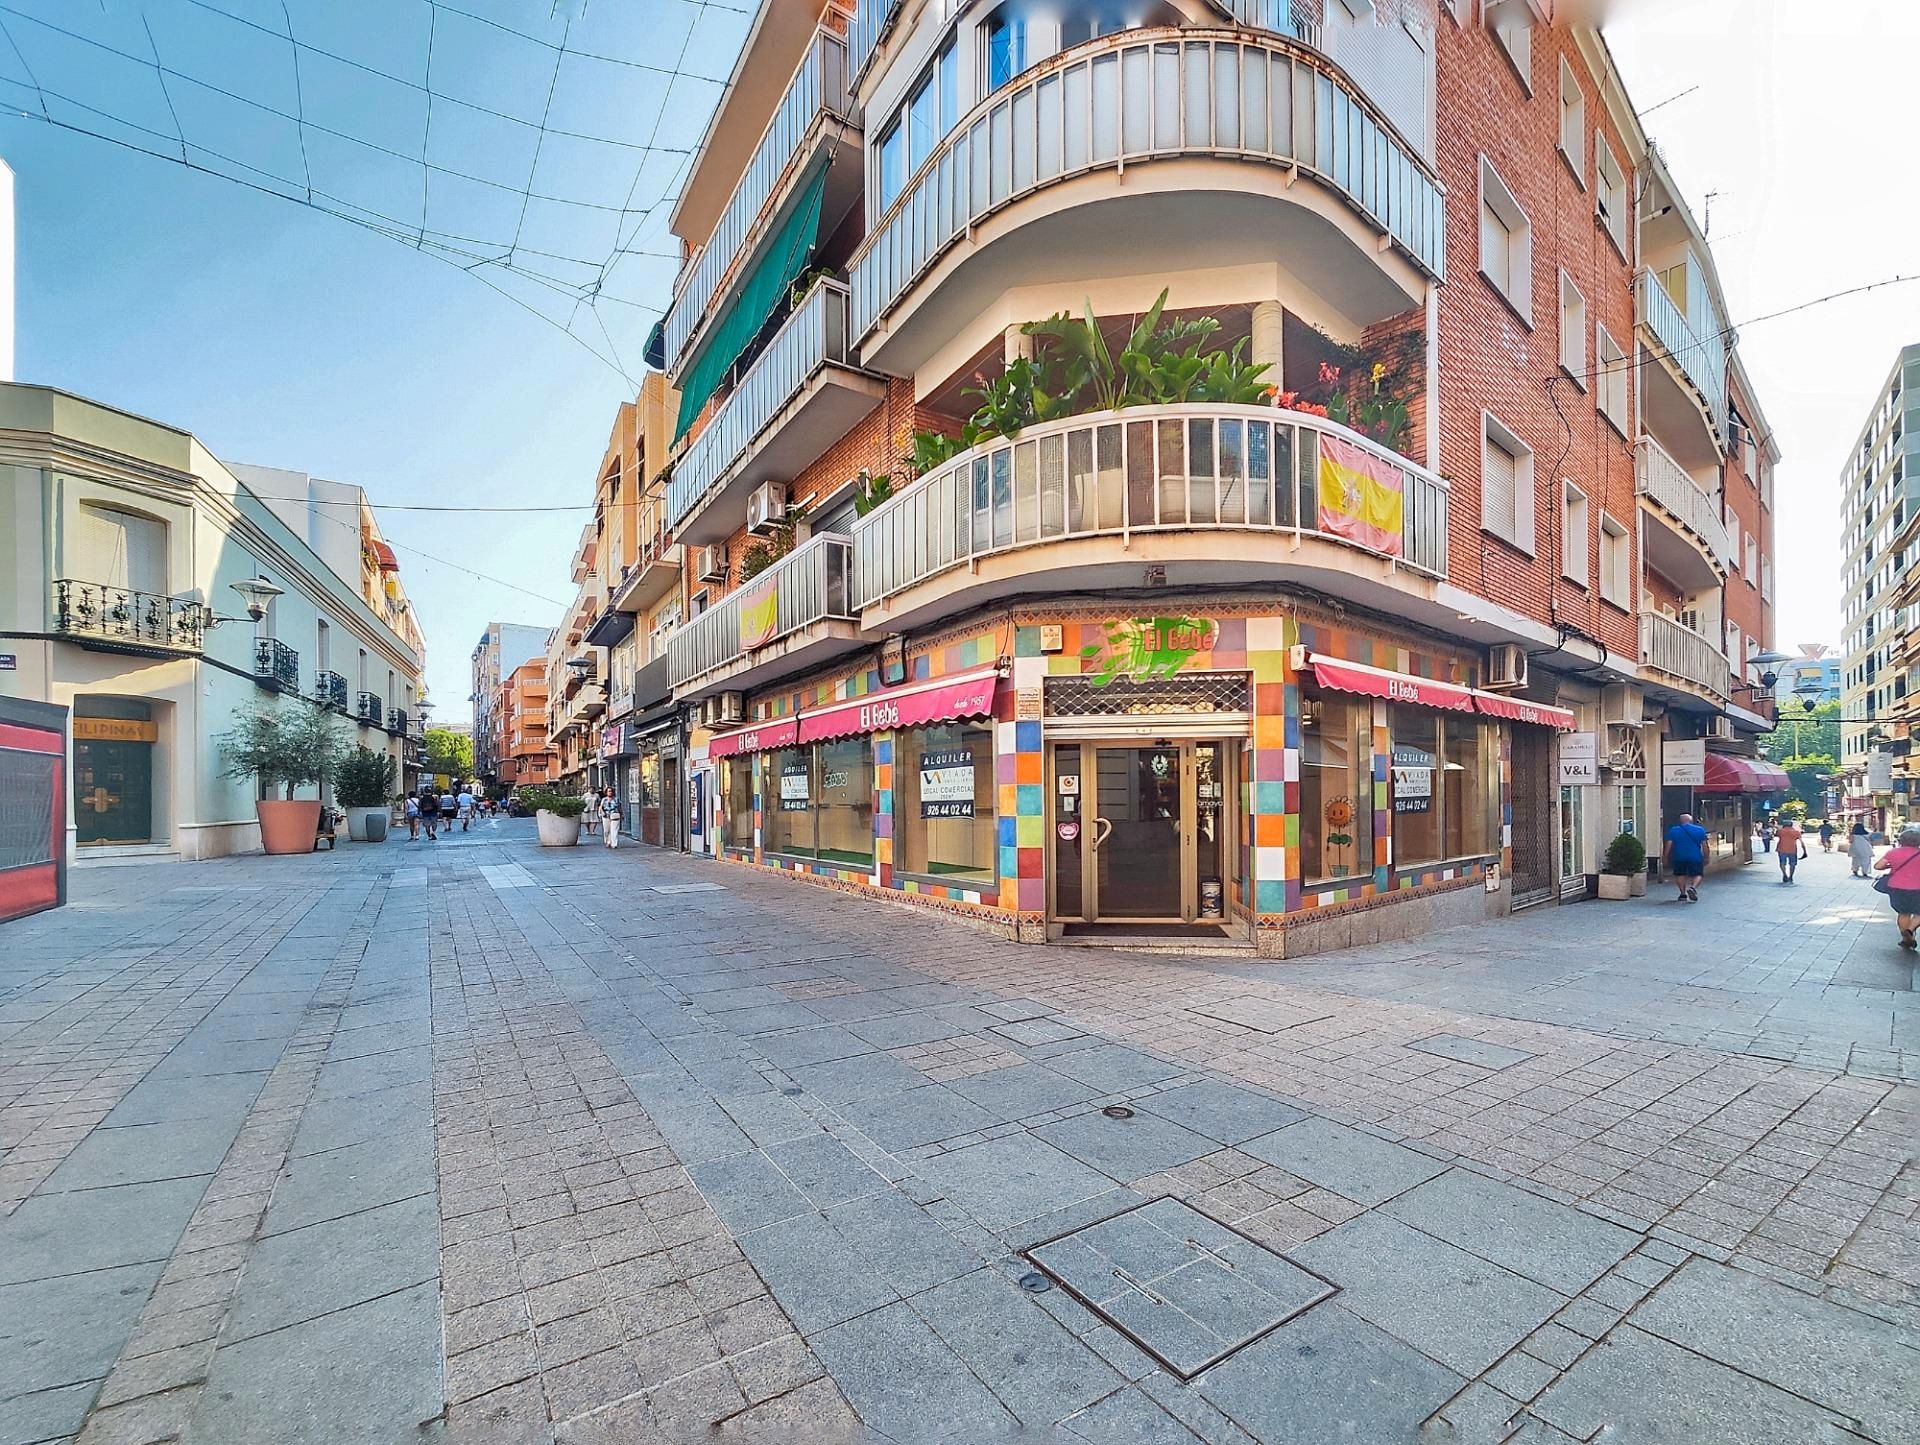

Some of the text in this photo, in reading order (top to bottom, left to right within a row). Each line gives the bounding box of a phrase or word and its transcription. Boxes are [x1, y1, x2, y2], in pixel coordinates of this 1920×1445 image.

[1144, 627, 1214, 651] El Bebé
[1389, 680, 1419, 700] El Bebé
[860, 700, 899, 728] El Bebé
[1520, 706, 1526, 719] El
[739, 734, 744, 751] El
[923, 751, 972, 766] ALQUILER
[1563, 764, 1592, 776] V&L
[924, 785, 975, 795] LOCAL COMERCIAL
[927, 803, 972, 816] 926 44 02 44
[1407, 800, 1414, 810] 44
[1421, 799, 1428, 810] 44
